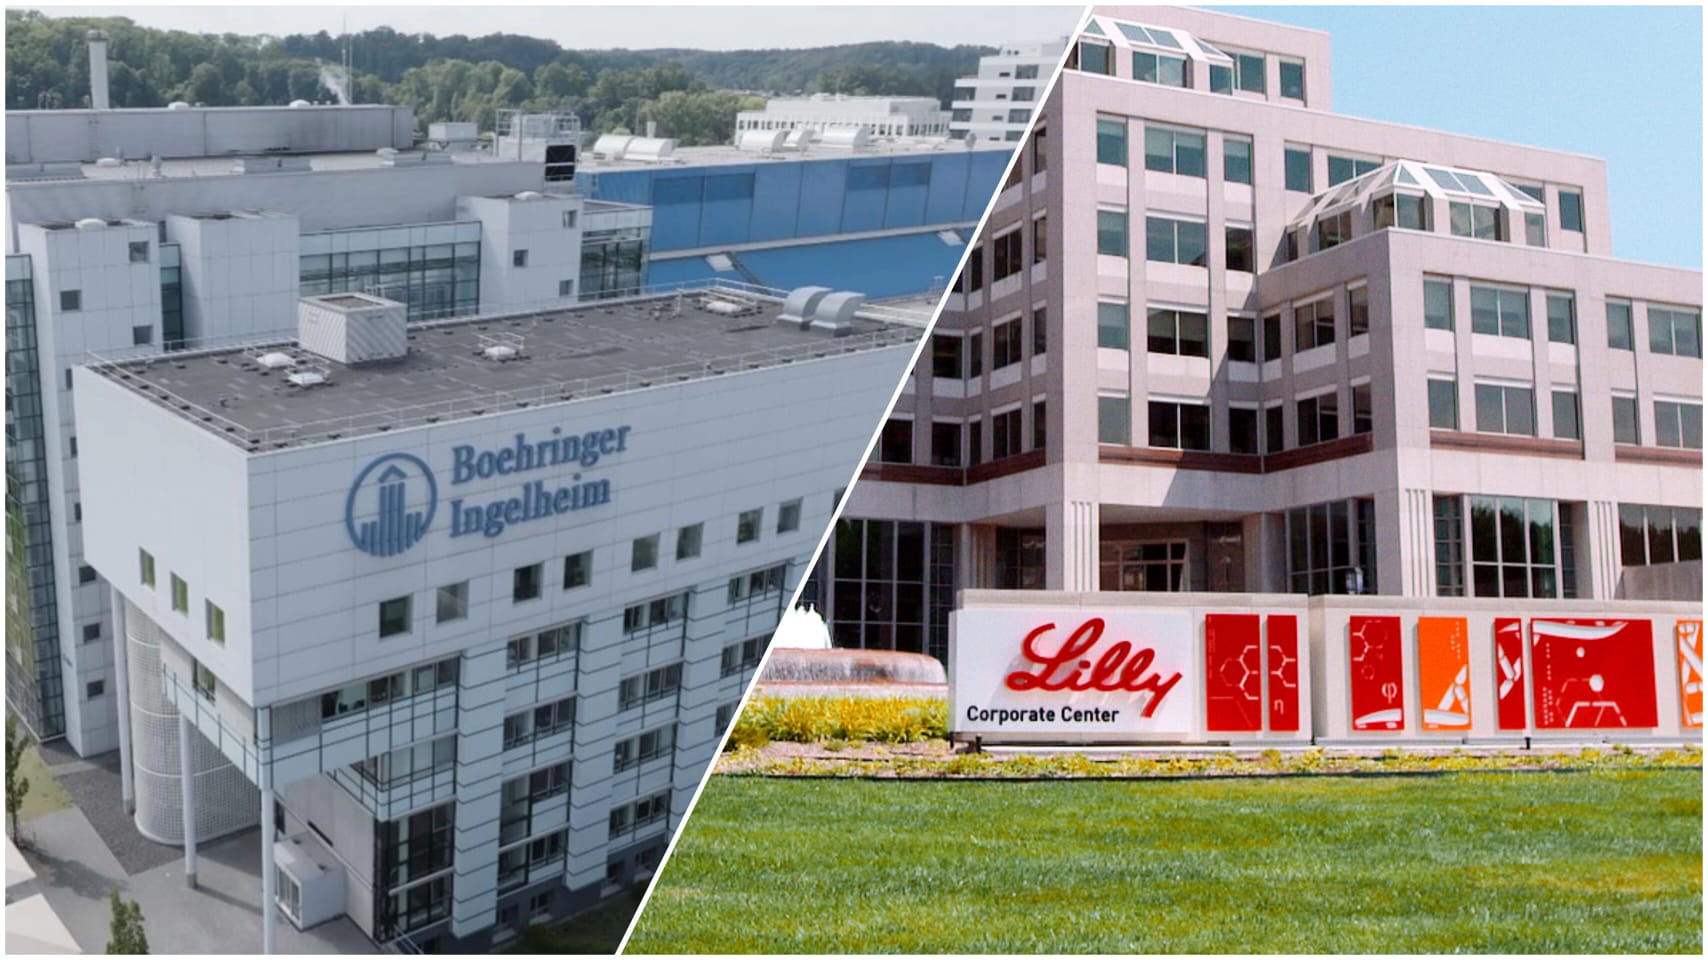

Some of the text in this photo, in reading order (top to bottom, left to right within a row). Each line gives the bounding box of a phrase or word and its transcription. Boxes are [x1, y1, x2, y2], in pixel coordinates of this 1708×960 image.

[450, 425, 632, 485] Boehringer
[450, 473, 612, 538] Ingelheim
[1004, 617, 1183, 718] Lilly
[967, 705, 1120, 726] Corporate Center
